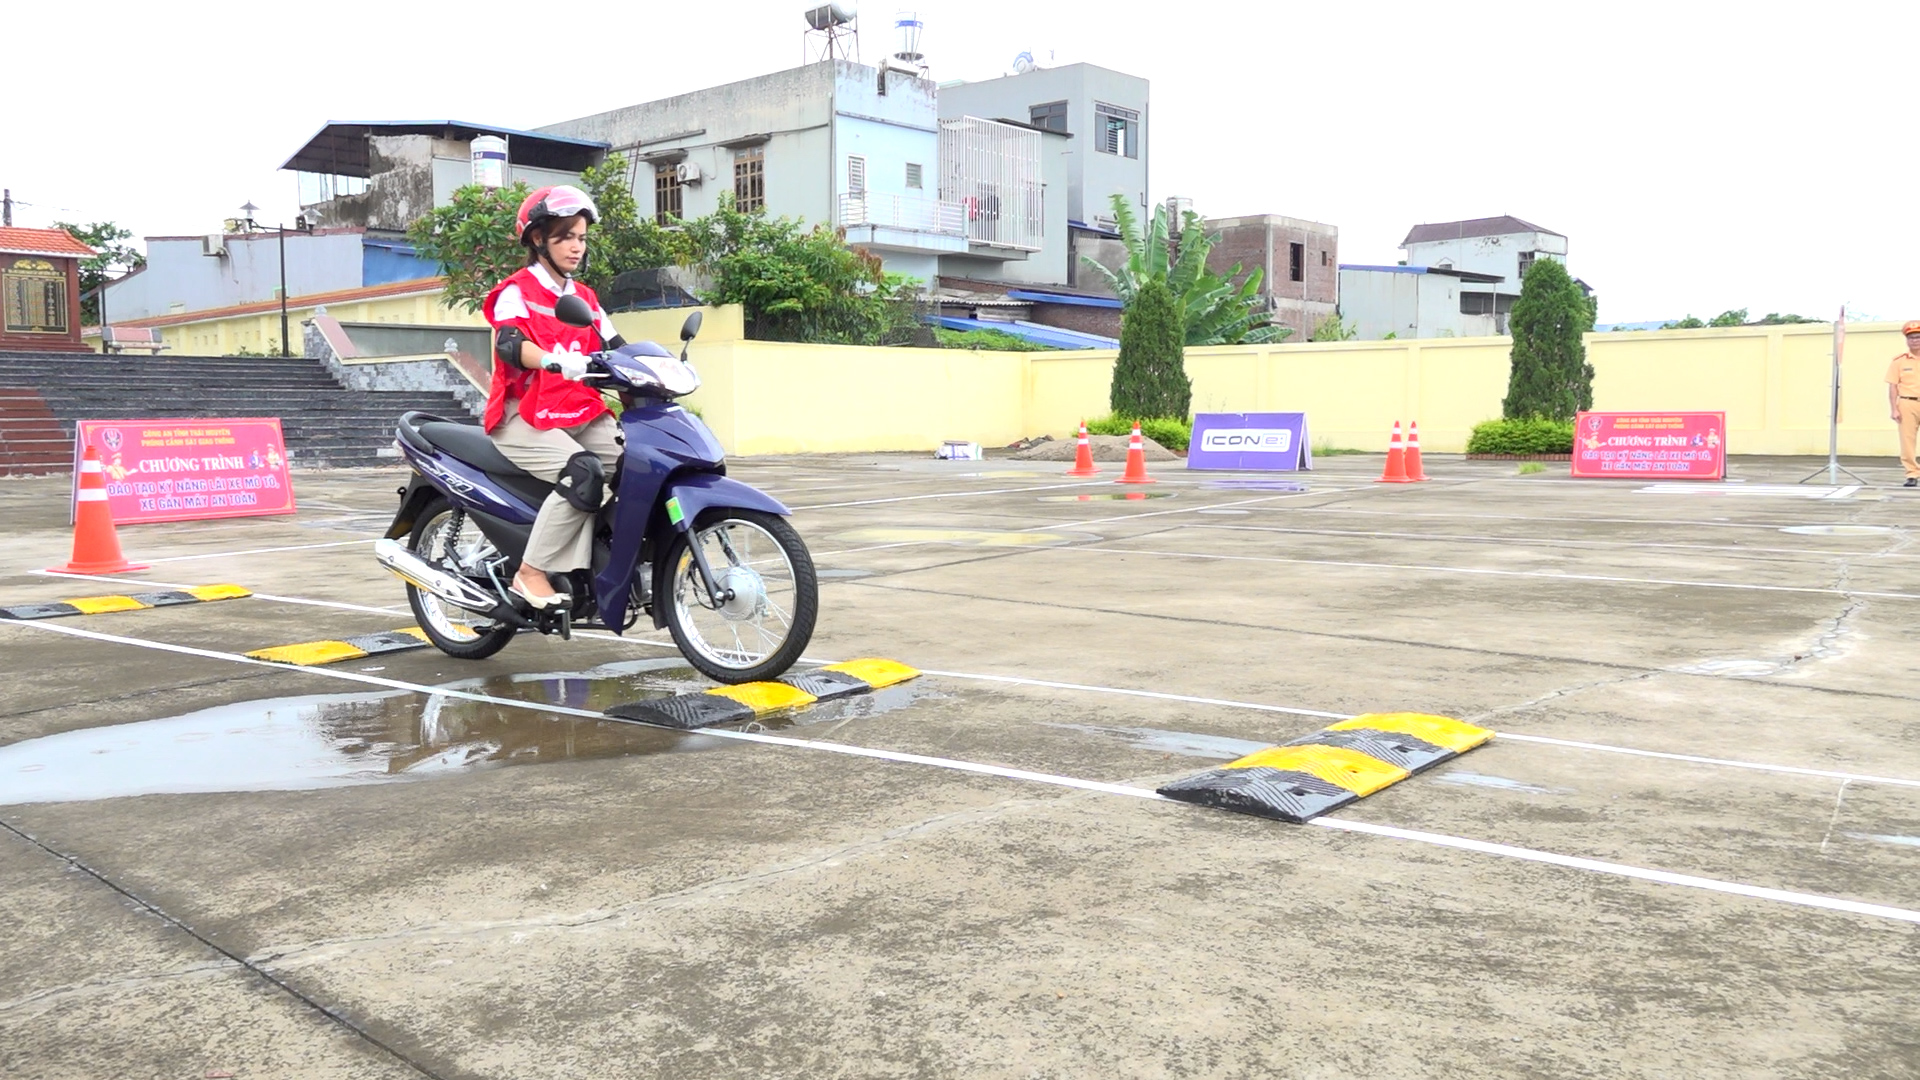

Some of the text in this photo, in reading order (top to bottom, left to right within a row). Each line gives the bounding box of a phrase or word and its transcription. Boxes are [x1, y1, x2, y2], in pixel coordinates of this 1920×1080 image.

[1206, 435, 1261, 445] ICON
[1607, 434, 1687, 446] CHƯƠNG TRÌNH
[139, 453, 245, 473] CHƯƠNG TRÌNH
[107, 481, 132, 497] ĐÀO
[135, 482, 156, 498] TẠO
[176, 478, 207, 493] NĂNG
[209, 477, 227, 491] LÁI
[228, 478, 241, 490] XE
[244, 475, 262, 489] MÔ
[140, 498, 156, 511] XE
[184, 494, 208, 508] MÁY
[211, 495, 227, 507] AN
[228, 491, 257, 506] TOÀN
